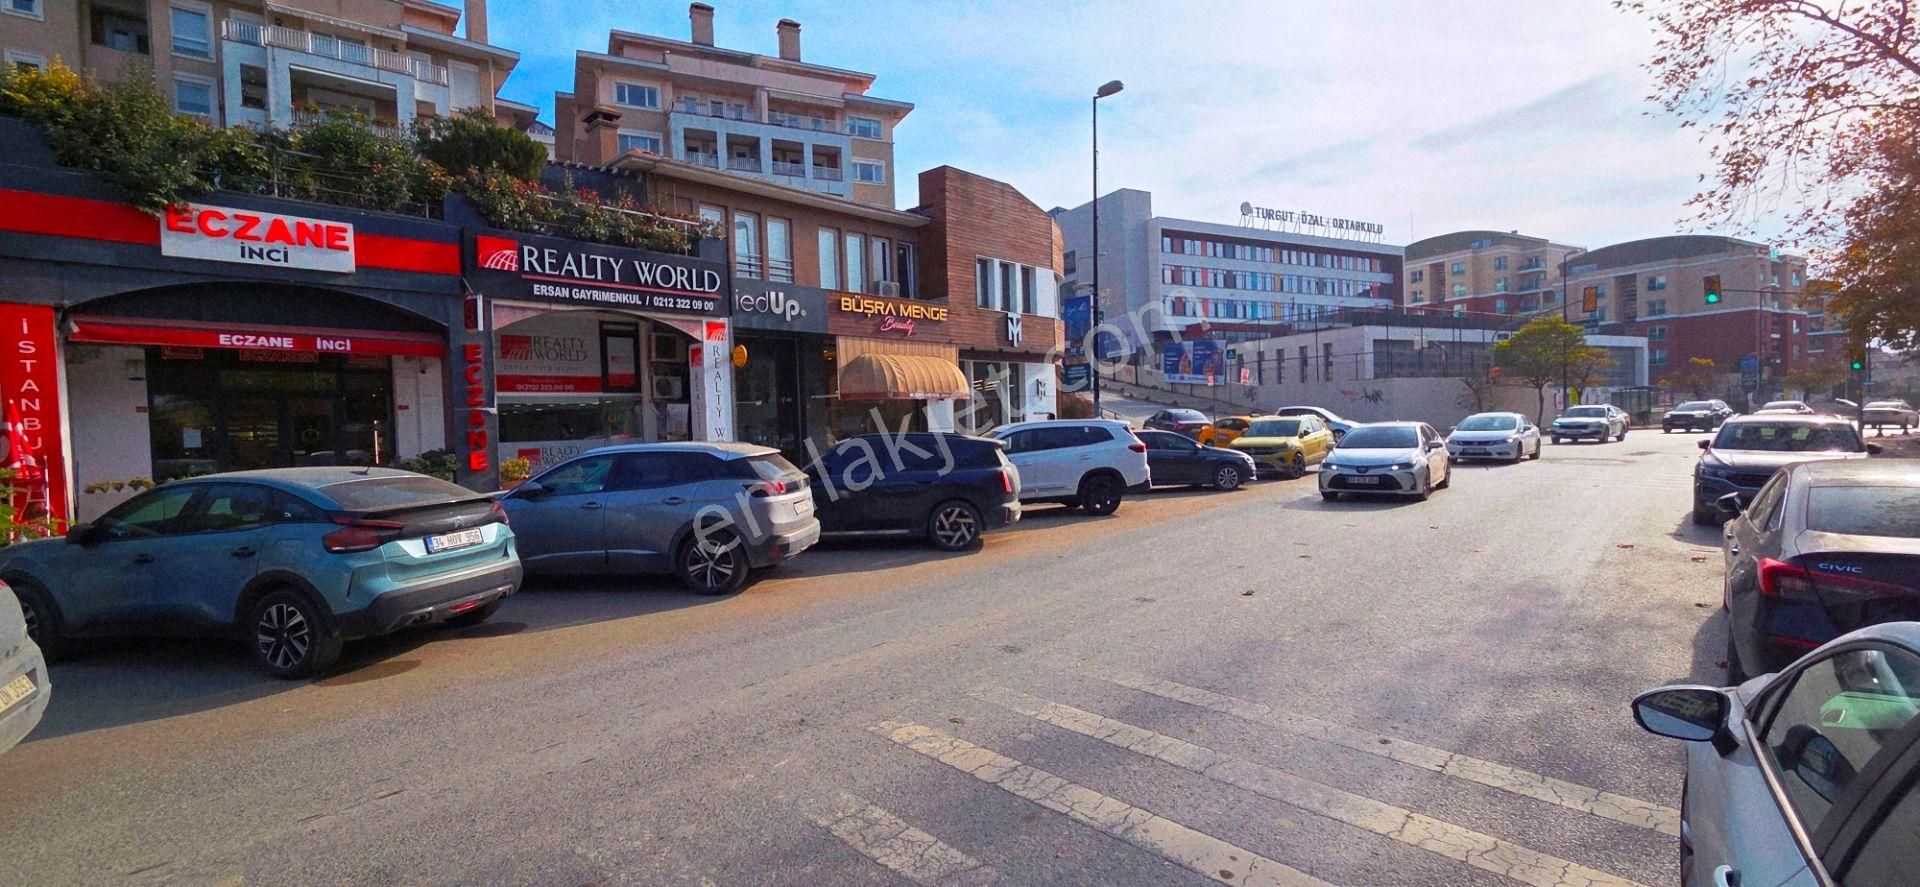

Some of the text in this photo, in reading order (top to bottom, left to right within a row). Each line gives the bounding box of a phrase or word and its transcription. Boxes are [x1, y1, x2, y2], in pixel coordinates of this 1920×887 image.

[164, 203, 350, 251] ECZANE
[1255, 207, 1295, 223] TURGUT
[1301, 211, 1325, 227] ÖZAL
[240, 242, 289, 263] İNCİ
[523, 245, 721, 293] REALTY WORLD
[533, 284, 569, 298] ERSAN
[572, 288, 642, 305] GAYRİMENKUL
[653, 296, 674, 308] 0212
[676, 298, 691, 309] 322
[692, 300, 702, 310] 09
[704, 301, 714, 311] 00
[840, 295, 949, 322] BÜŞRA MENGE
[219, 334, 351, 350] ECZANE İNCİ
[533, 336, 585, 350] REALTY
[533, 348, 588, 361] WORLD
[713, 345, 723, 417] REALTY
[464, 343, 488, 471] ECZANE
[1818, 562, 1864, 574] CIVIC
